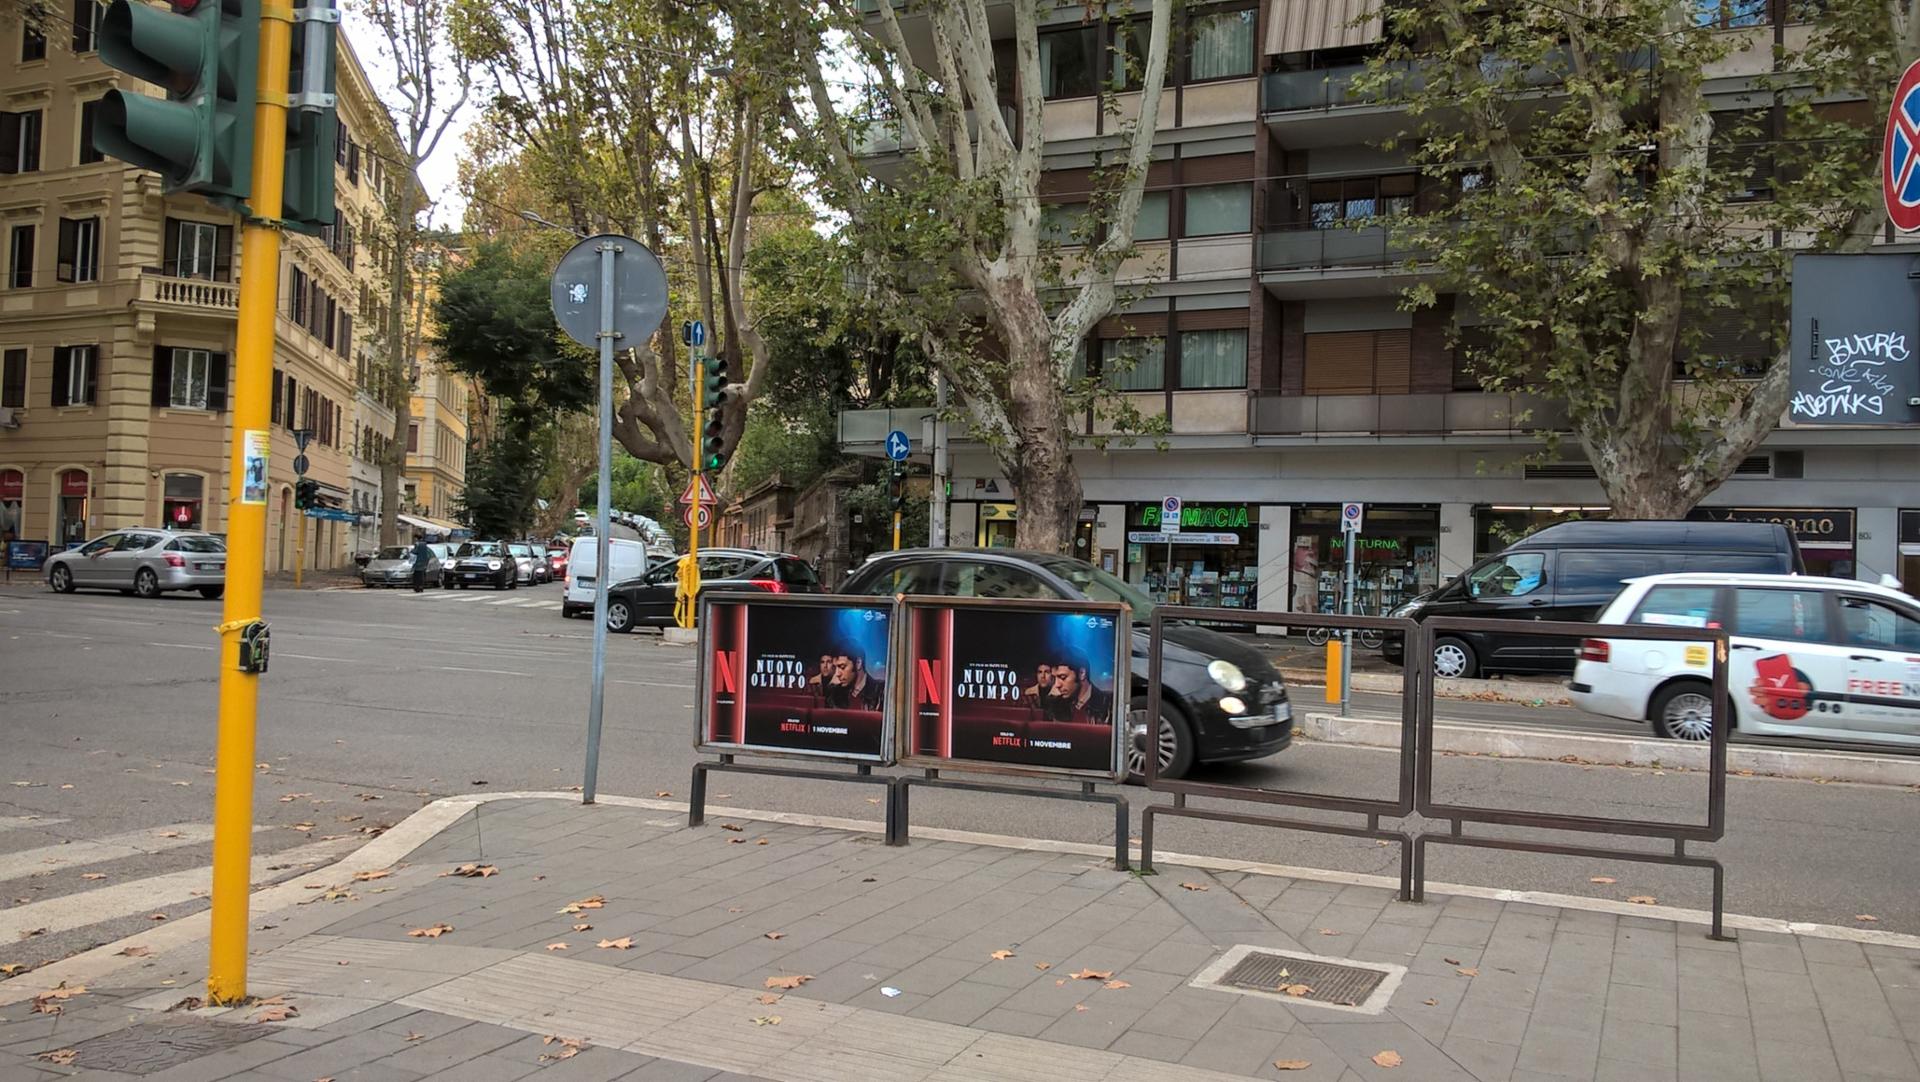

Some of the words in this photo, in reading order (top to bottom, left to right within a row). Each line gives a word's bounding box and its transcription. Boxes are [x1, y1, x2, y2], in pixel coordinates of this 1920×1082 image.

[1142, 506, 1249, 527] FMACIA
[1332, 539, 1400, 550] NTURNA
[756, 659, 803, 675] NUOVO
[751, 673, 806, 689] OLIMPO
[964, 669, 1017, 686] NUOVO
[958, 684, 1020, 701] OLIMPO
[781, 723, 805, 732] NETFLIX
[816, 726, 848, 735] NOVEMBRE
[992, 736, 1021, 747] NETFLIX
[1034, 741, 1072, 750] NOVEMBRE
